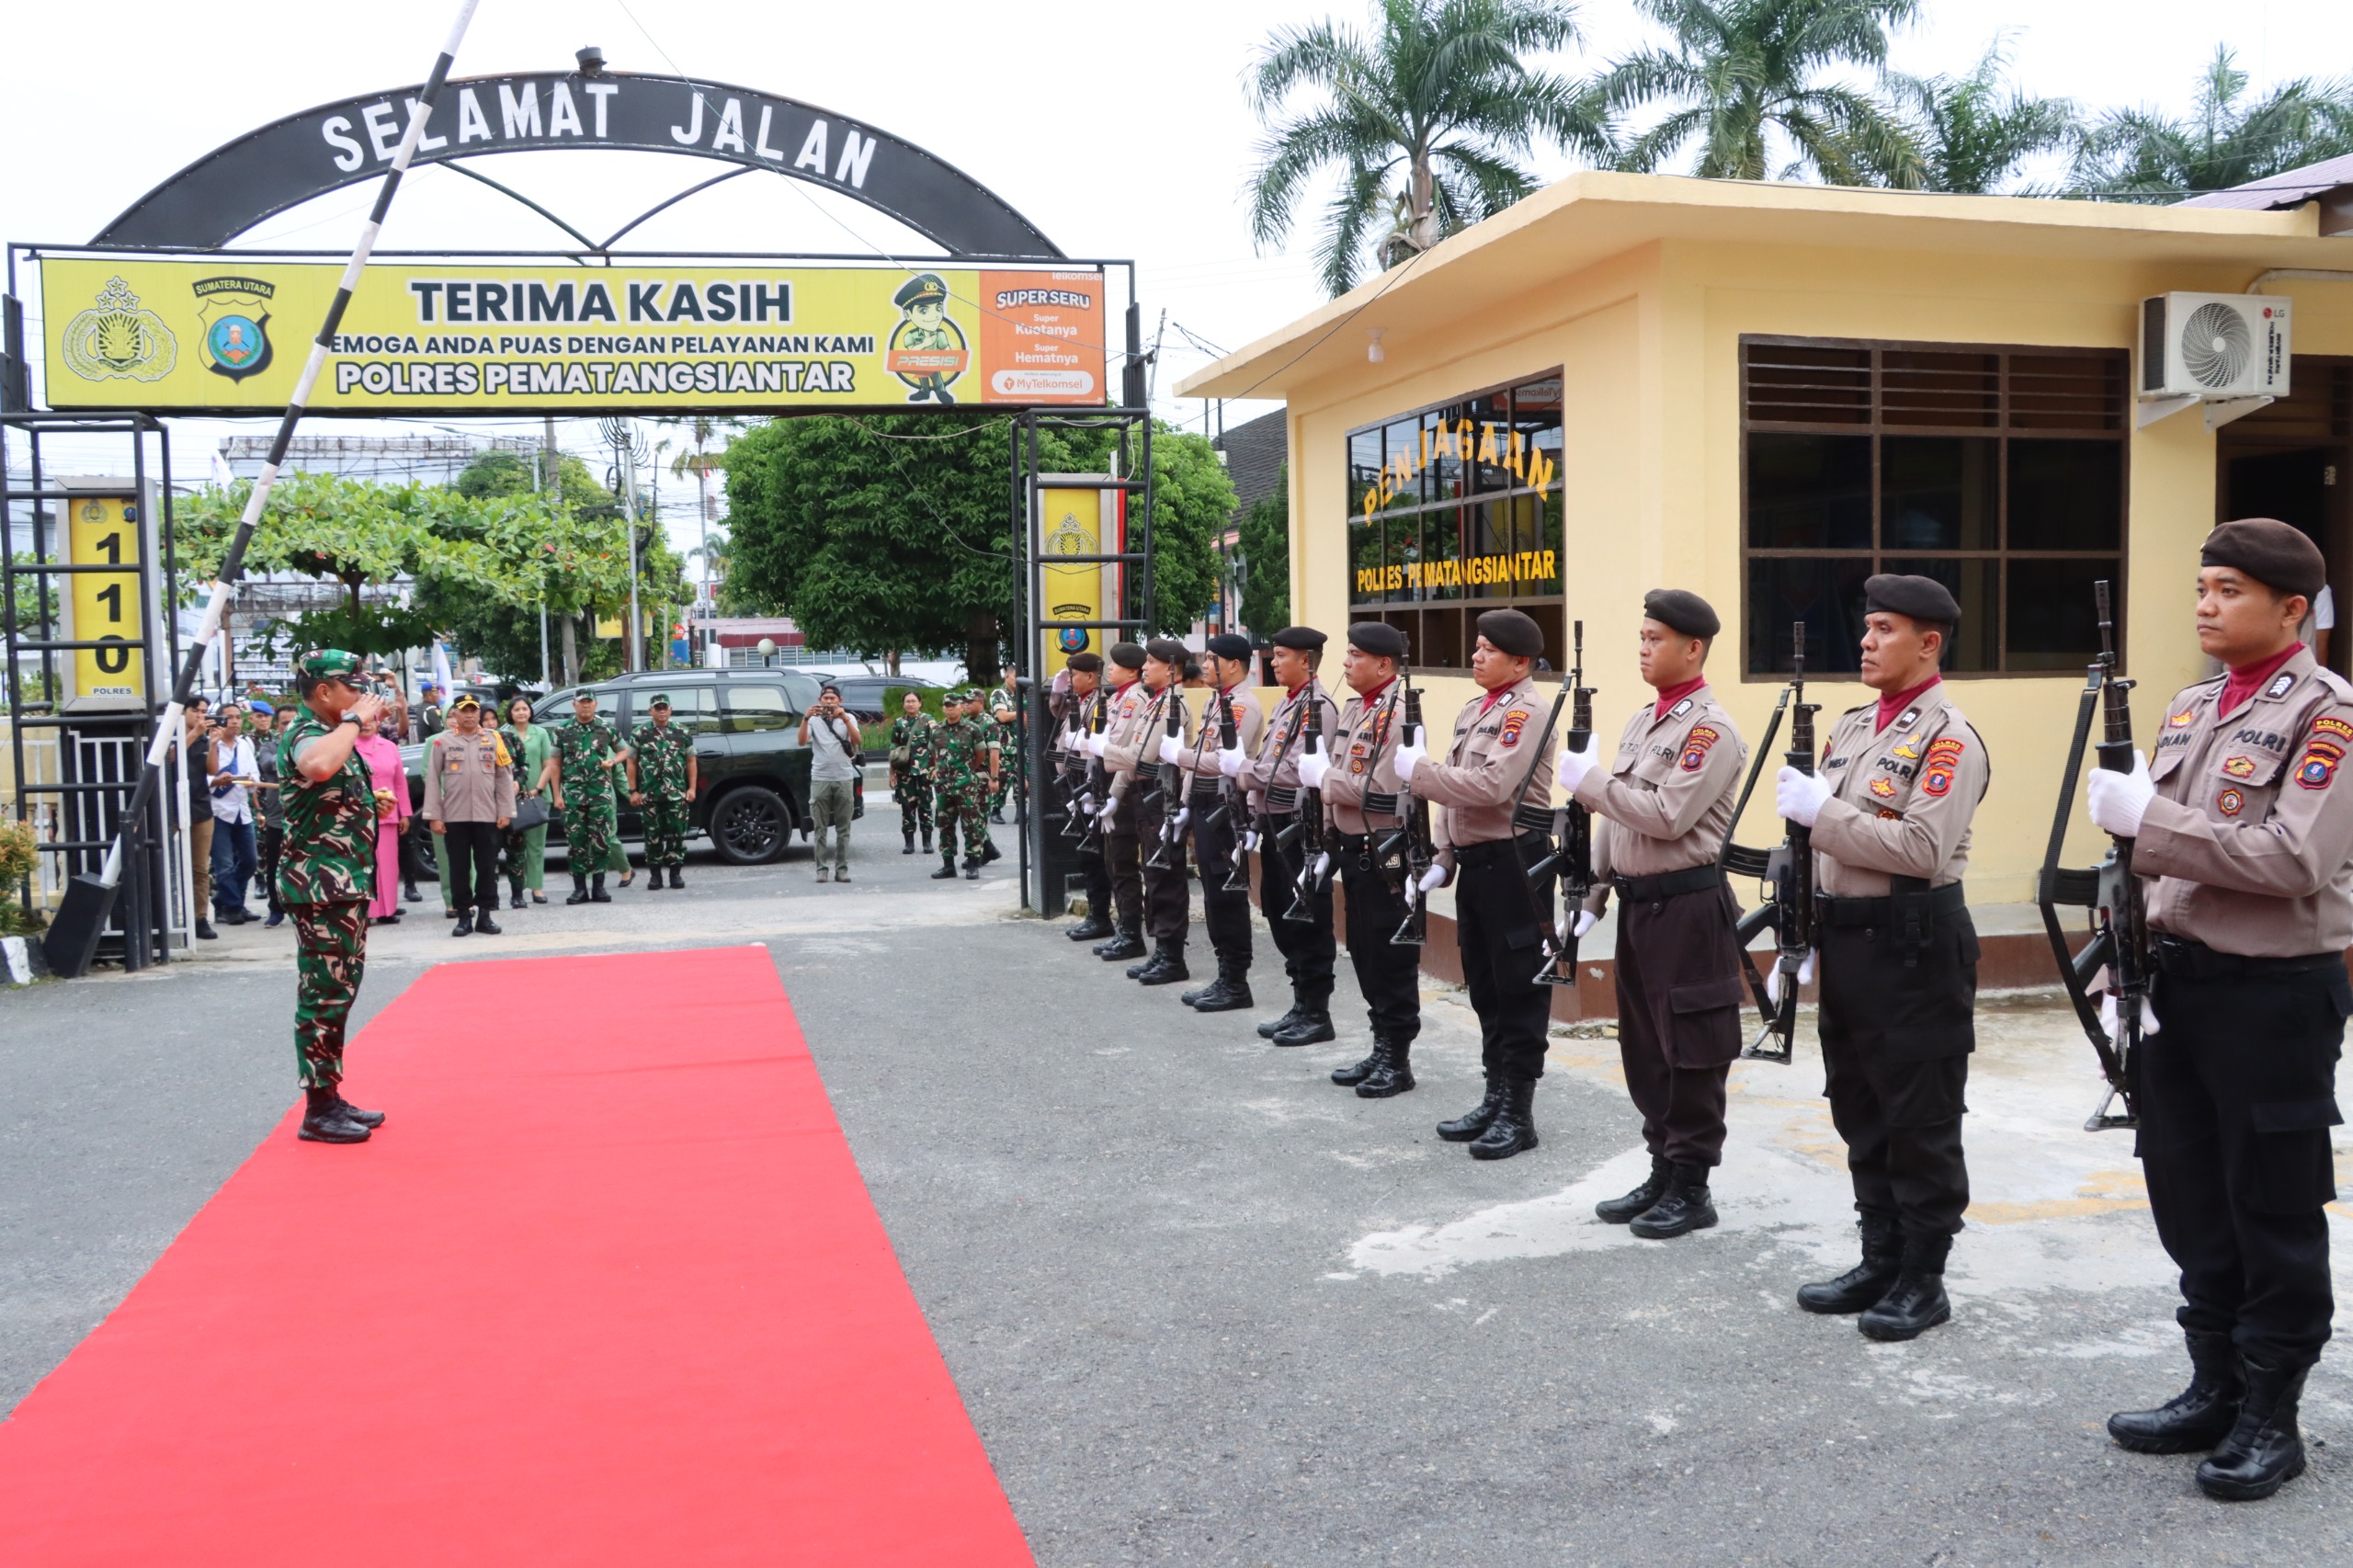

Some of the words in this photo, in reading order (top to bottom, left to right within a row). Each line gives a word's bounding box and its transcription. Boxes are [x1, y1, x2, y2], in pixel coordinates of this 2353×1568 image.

[322, 81, 619, 173] SELAMAT
[671, 92, 877, 189] JALAN
[196, 279, 242, 295] SUMATERA
[244, 281, 272, 296] UTARA
[411, 282, 617, 323] TERIMA
[629, 283, 790, 323] KASIH
[996, 290, 1048, 309] SUPER
[1050, 290, 1090, 309] SERU
[1033, 313, 1059, 324] Super
[2274, 309, 2285, 318] LG
[1015, 324, 1078, 337] Kuotanya
[316, 336, 418, 354] EMOGA
[425, 336, 494, 354] ANDA
[501, 336, 563, 354] PUAS
[568, 336, 665, 354] DENGAN
[671, 336, 809, 354] PELAYANAN
[814, 336, 874, 354] KAMI
[1034, 344, 1059, 353] Super
[897, 356, 960, 367] PRESISI
[1015, 352, 1078, 366] Hematnya
[336, 362, 479, 394] POLRES
[484, 362, 855, 394] PEMATANGSIANTAR
[1017, 379, 1083, 390] MyTelkomsel
[1363, 417, 1554, 528] PENJAGAAN
[1358, 564, 1403, 593] POLRES
[1407, 550, 1556, 589] PEMATANGSIANTAR
[1054, 606, 1075, 614] SUMATERA
[2316, 719, 2353, 735] POLRES
[2233, 729, 2287, 753] POLRI
